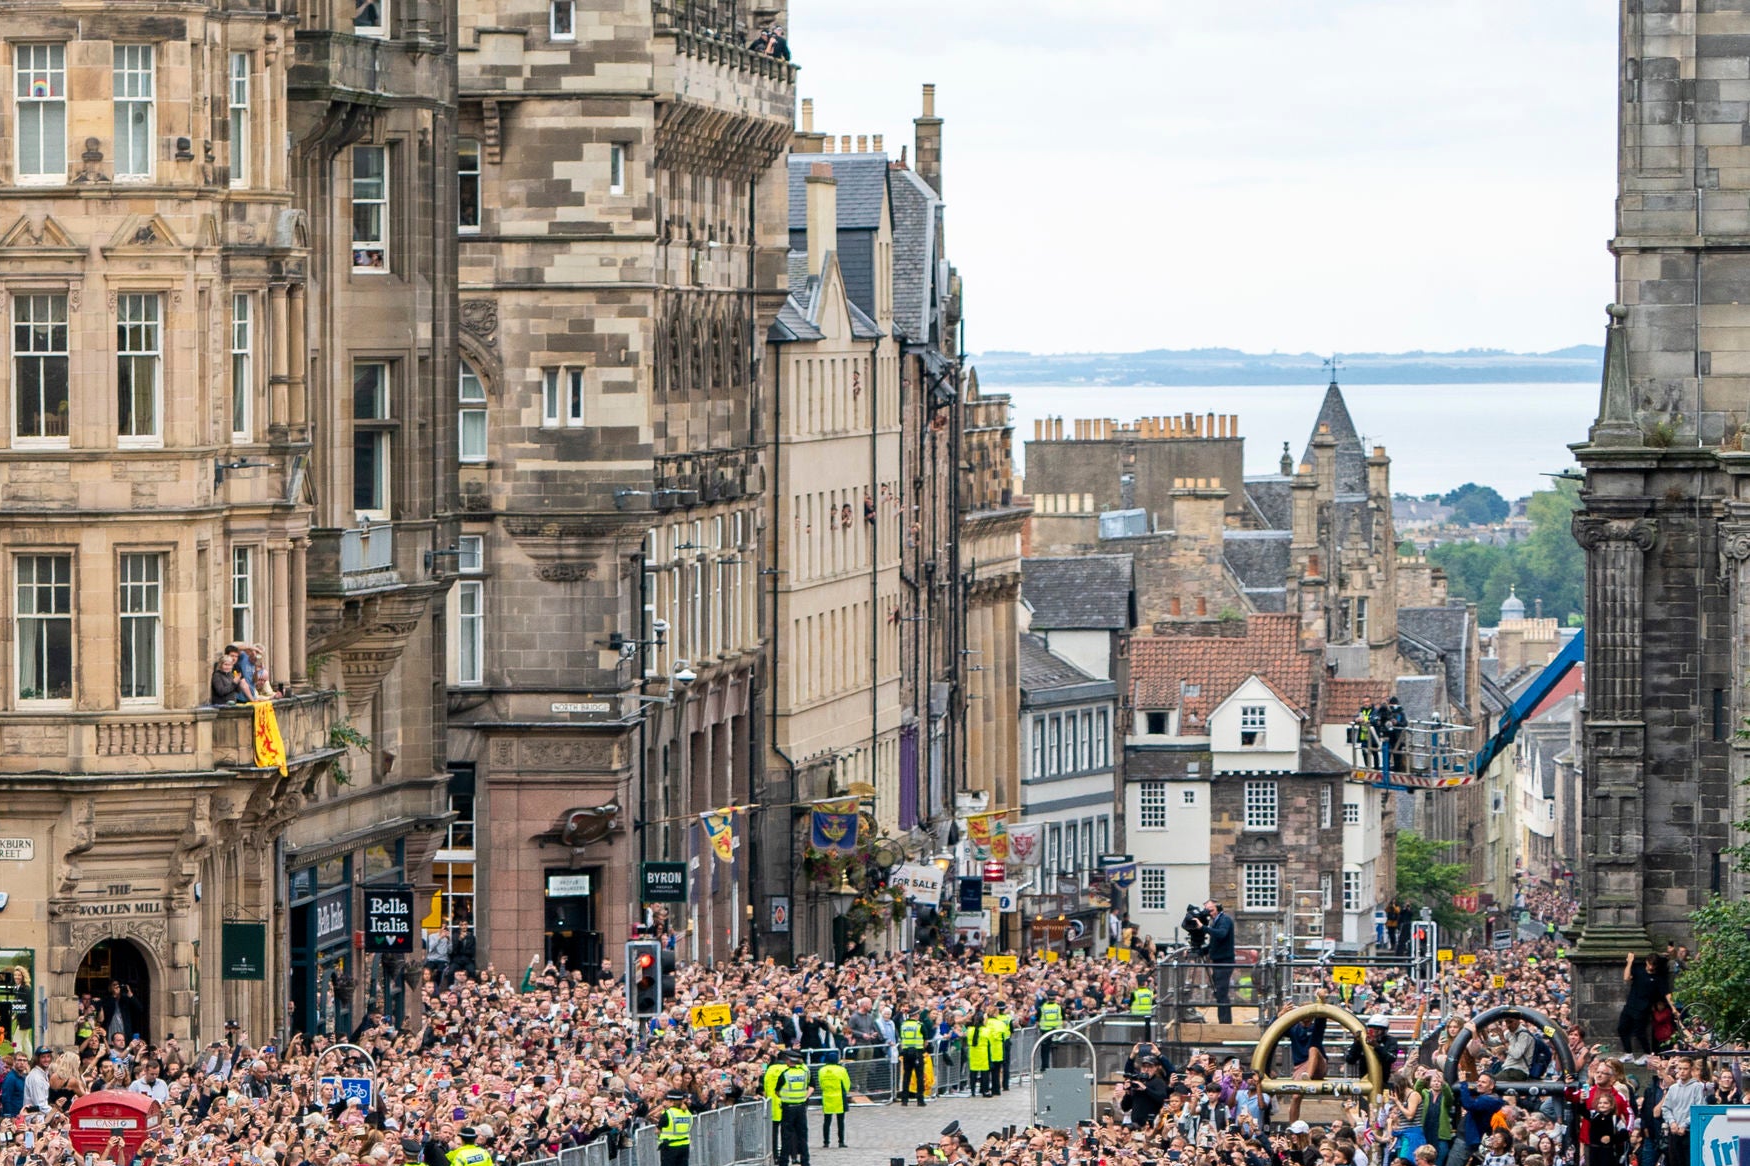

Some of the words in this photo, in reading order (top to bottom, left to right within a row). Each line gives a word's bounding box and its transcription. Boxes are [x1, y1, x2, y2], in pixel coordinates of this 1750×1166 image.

[554, 704, 578, 712] NORTH
[580, 704, 607, 712] BRIDGE
[647, 872, 682, 884] BYRON
[892, 877, 910, 886] FOR
[912, 878, 939, 889] SALE
[107, 884, 131, 896] THE
[78, 903, 132, 915] WOOLLEN
[134, 902, 162, 914] MILL
[370, 897, 409, 914] Bella
[370, 916, 409, 932] Italia
[1321, 1082, 1351, 1096] EXIT
[95, 1120, 119, 1128] CASH
